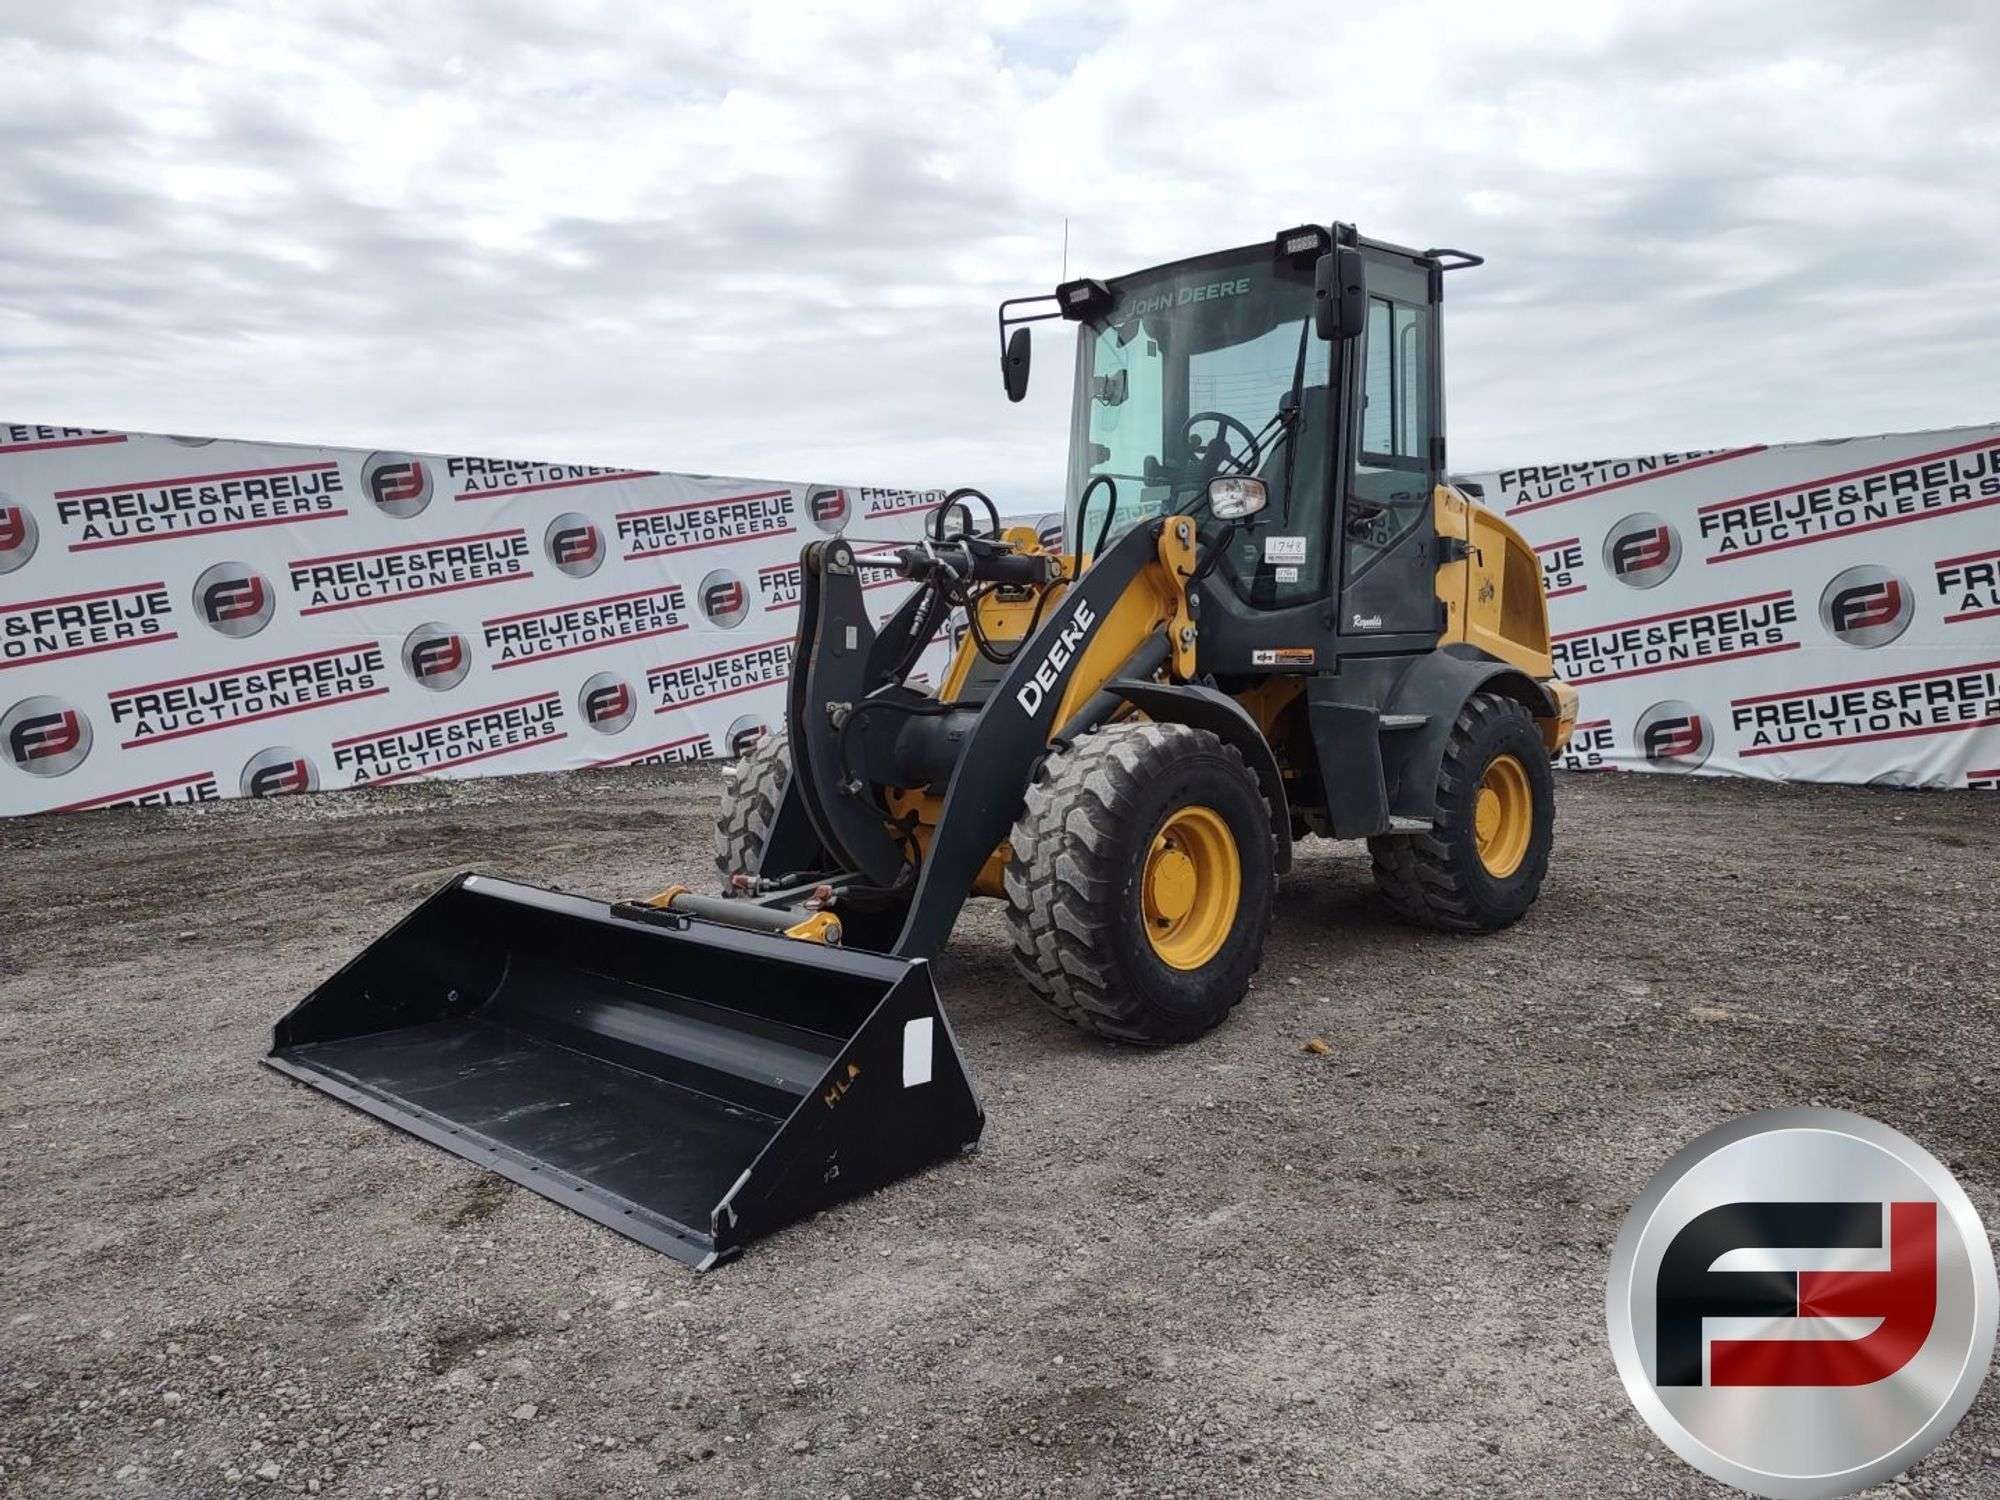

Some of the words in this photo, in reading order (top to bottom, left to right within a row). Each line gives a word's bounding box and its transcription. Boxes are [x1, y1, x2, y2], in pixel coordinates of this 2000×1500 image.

[1126, 292, 1173, 317] JOHN
[1176, 278, 1250, 305] DEERE
[57, 470, 344, 524] FREIJE&FREIJE
[82, 495, 333, 541] AUCTIONEERS
[617, 497, 794, 540] FREIJE&FREIJE
[1720, 477, 2000, 552] AUCTIONEERS
[632, 516, 788, 552] AUCTIONEERS
[290, 537, 530, 591] FREIJE&FREIJE
[311, 559, 521, 605] AUCTIONEERS
[1936, 561, 2000, 595] FR
[4, 618, 160, 658] ONEERS
[483, 592, 687, 647] FREIJE&FREIJE
[501, 612, 679, 660] AUCTIONEERS
[661, 664, 790, 705] AUCTIONEE
[1016, 600, 1096, 717] DEERE
[111, 651, 385, 723] FREIJE&FREIJE
[135, 675, 375, 738] AUCTIONEERS
[1732, 673, 2000, 731] FREIJE&FREI
[333, 699, 564, 770] FREIJE&FREIJE
[354, 722, 555, 783] AUCTIONEERS
